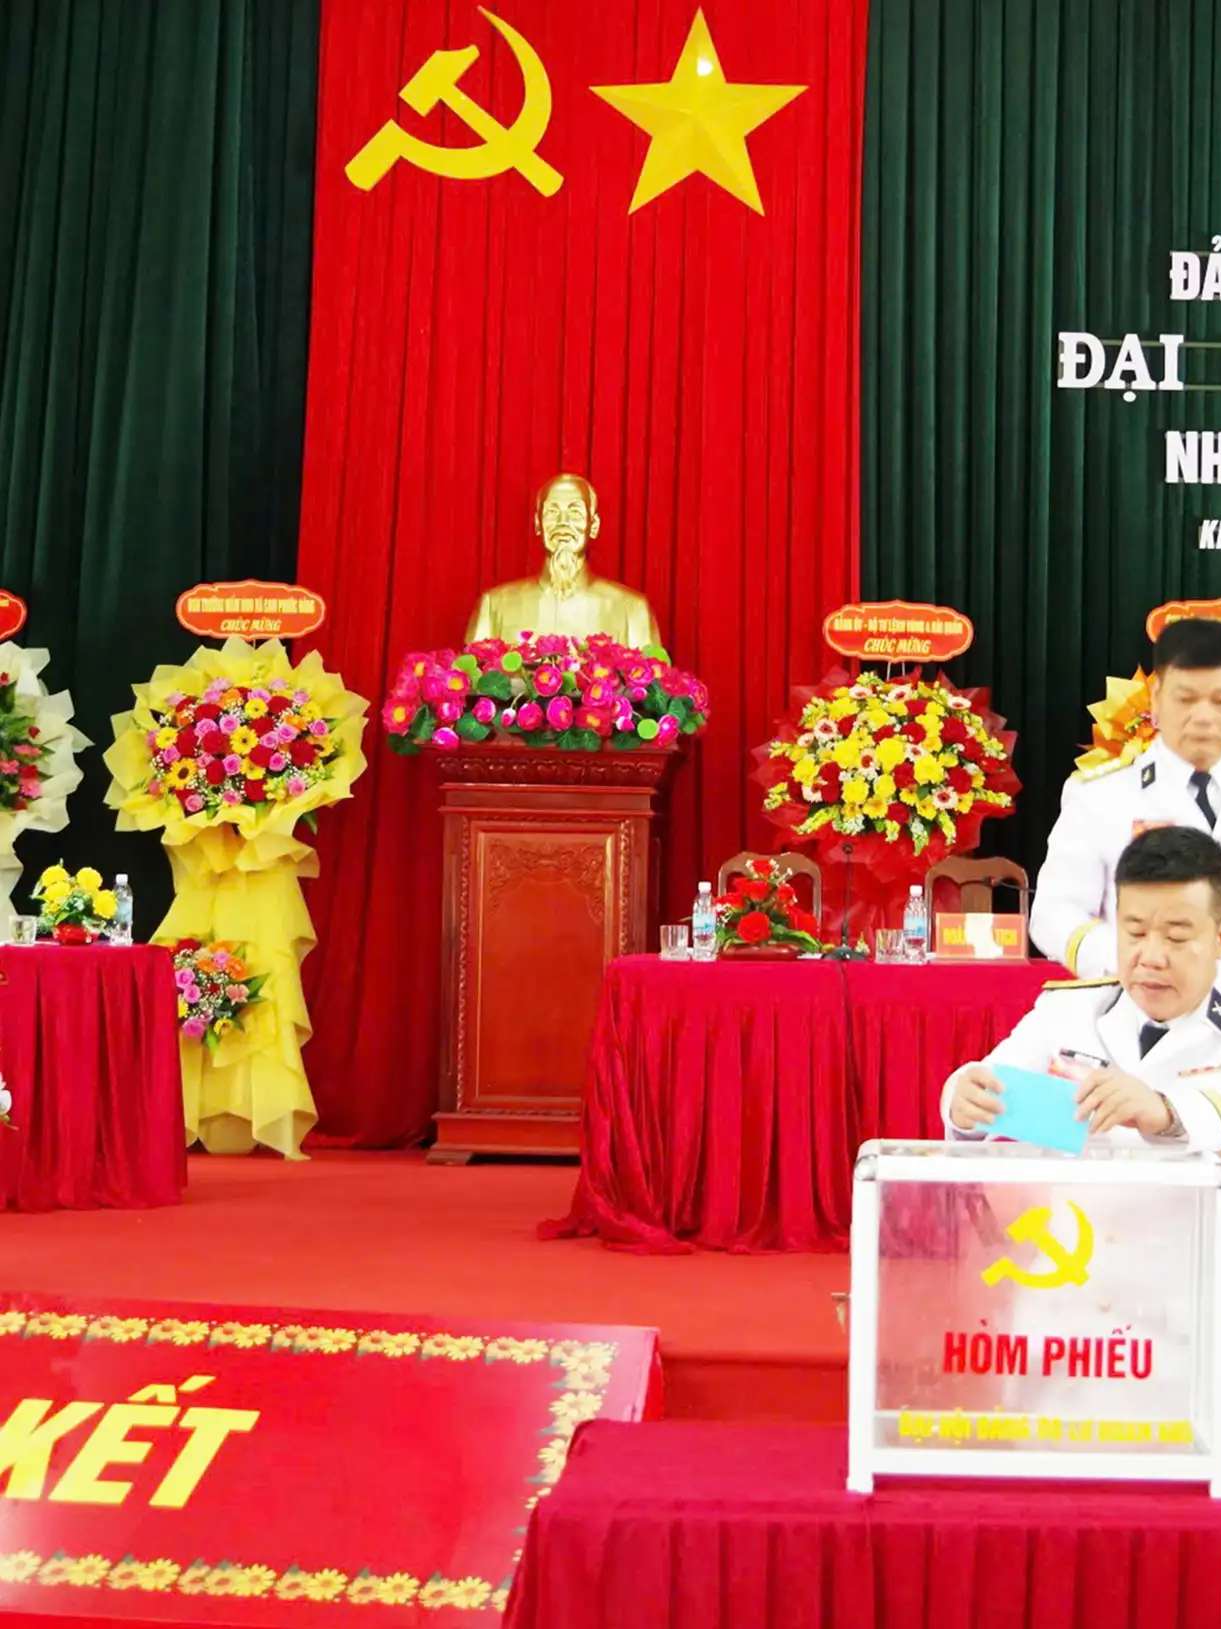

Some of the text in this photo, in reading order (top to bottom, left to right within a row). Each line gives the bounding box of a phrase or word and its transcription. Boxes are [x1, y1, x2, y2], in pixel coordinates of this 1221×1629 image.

[1058, 333, 1184, 402] ĐẠI
[220, 617, 282, 631] CHÚC MỪNG
[864, 635, 931, 653] CHÚC MỪNG
[943, 1319, 1152, 1379] HÒM PHIẾU
[0, 1376, 260, 1508] KẾT
